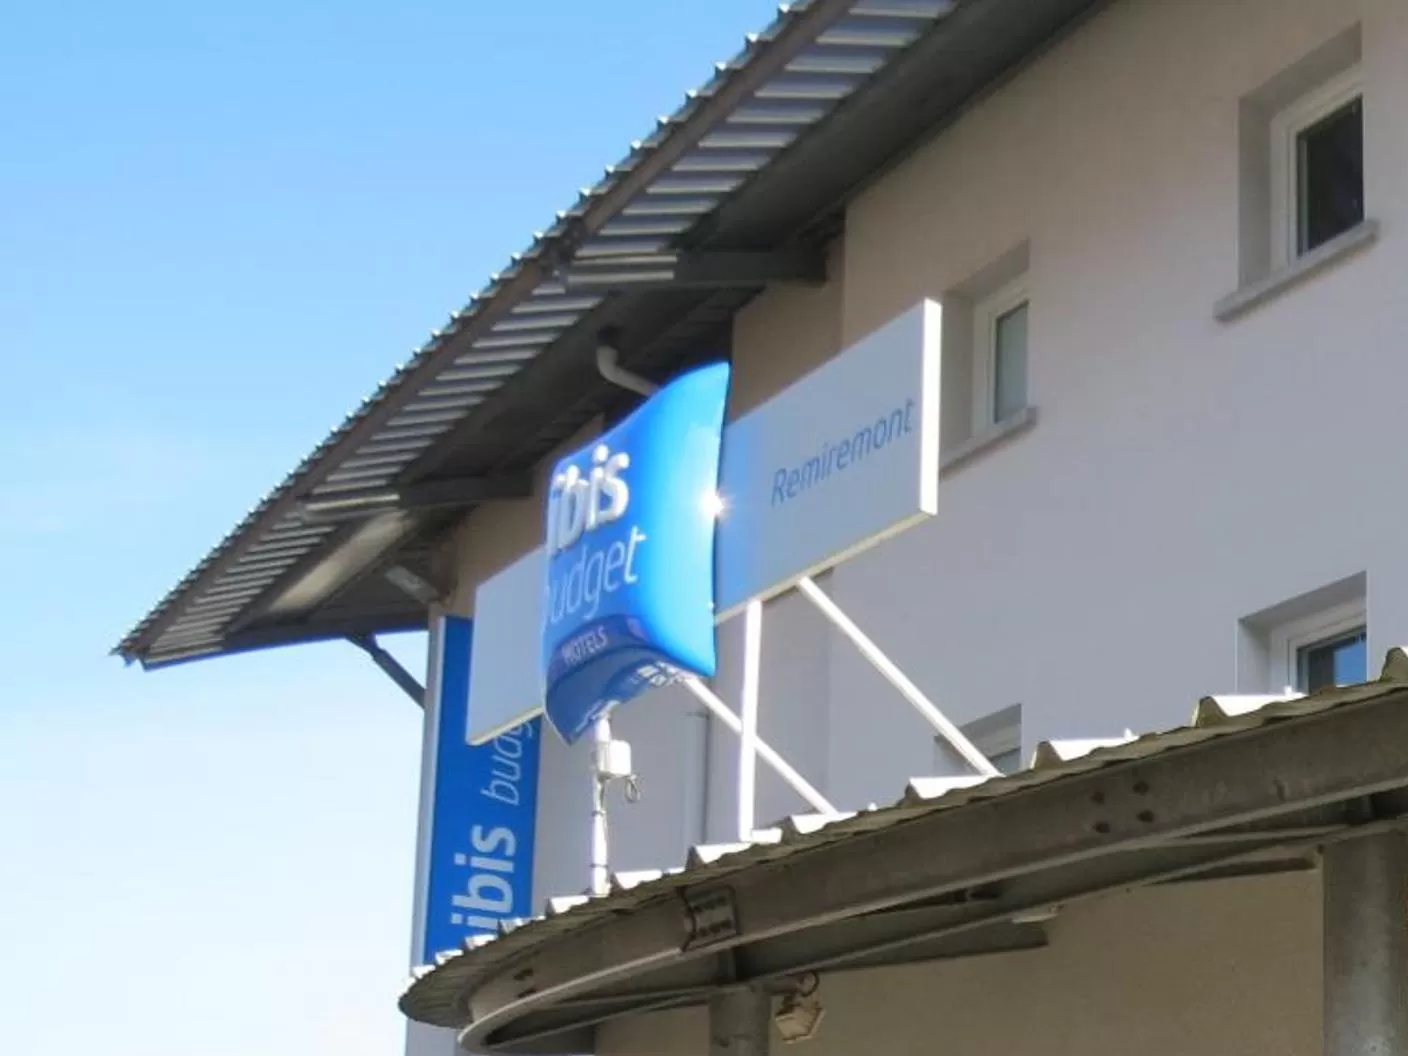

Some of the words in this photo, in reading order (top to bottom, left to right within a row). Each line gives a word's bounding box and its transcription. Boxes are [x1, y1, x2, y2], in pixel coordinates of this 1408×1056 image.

[547, 443, 630, 554] ibis
[771, 398, 915, 507] Remiremont
[541, 525, 647, 630] udget
[562, 625, 609, 666] HOTELS
[451, 823, 517, 932] ibis
